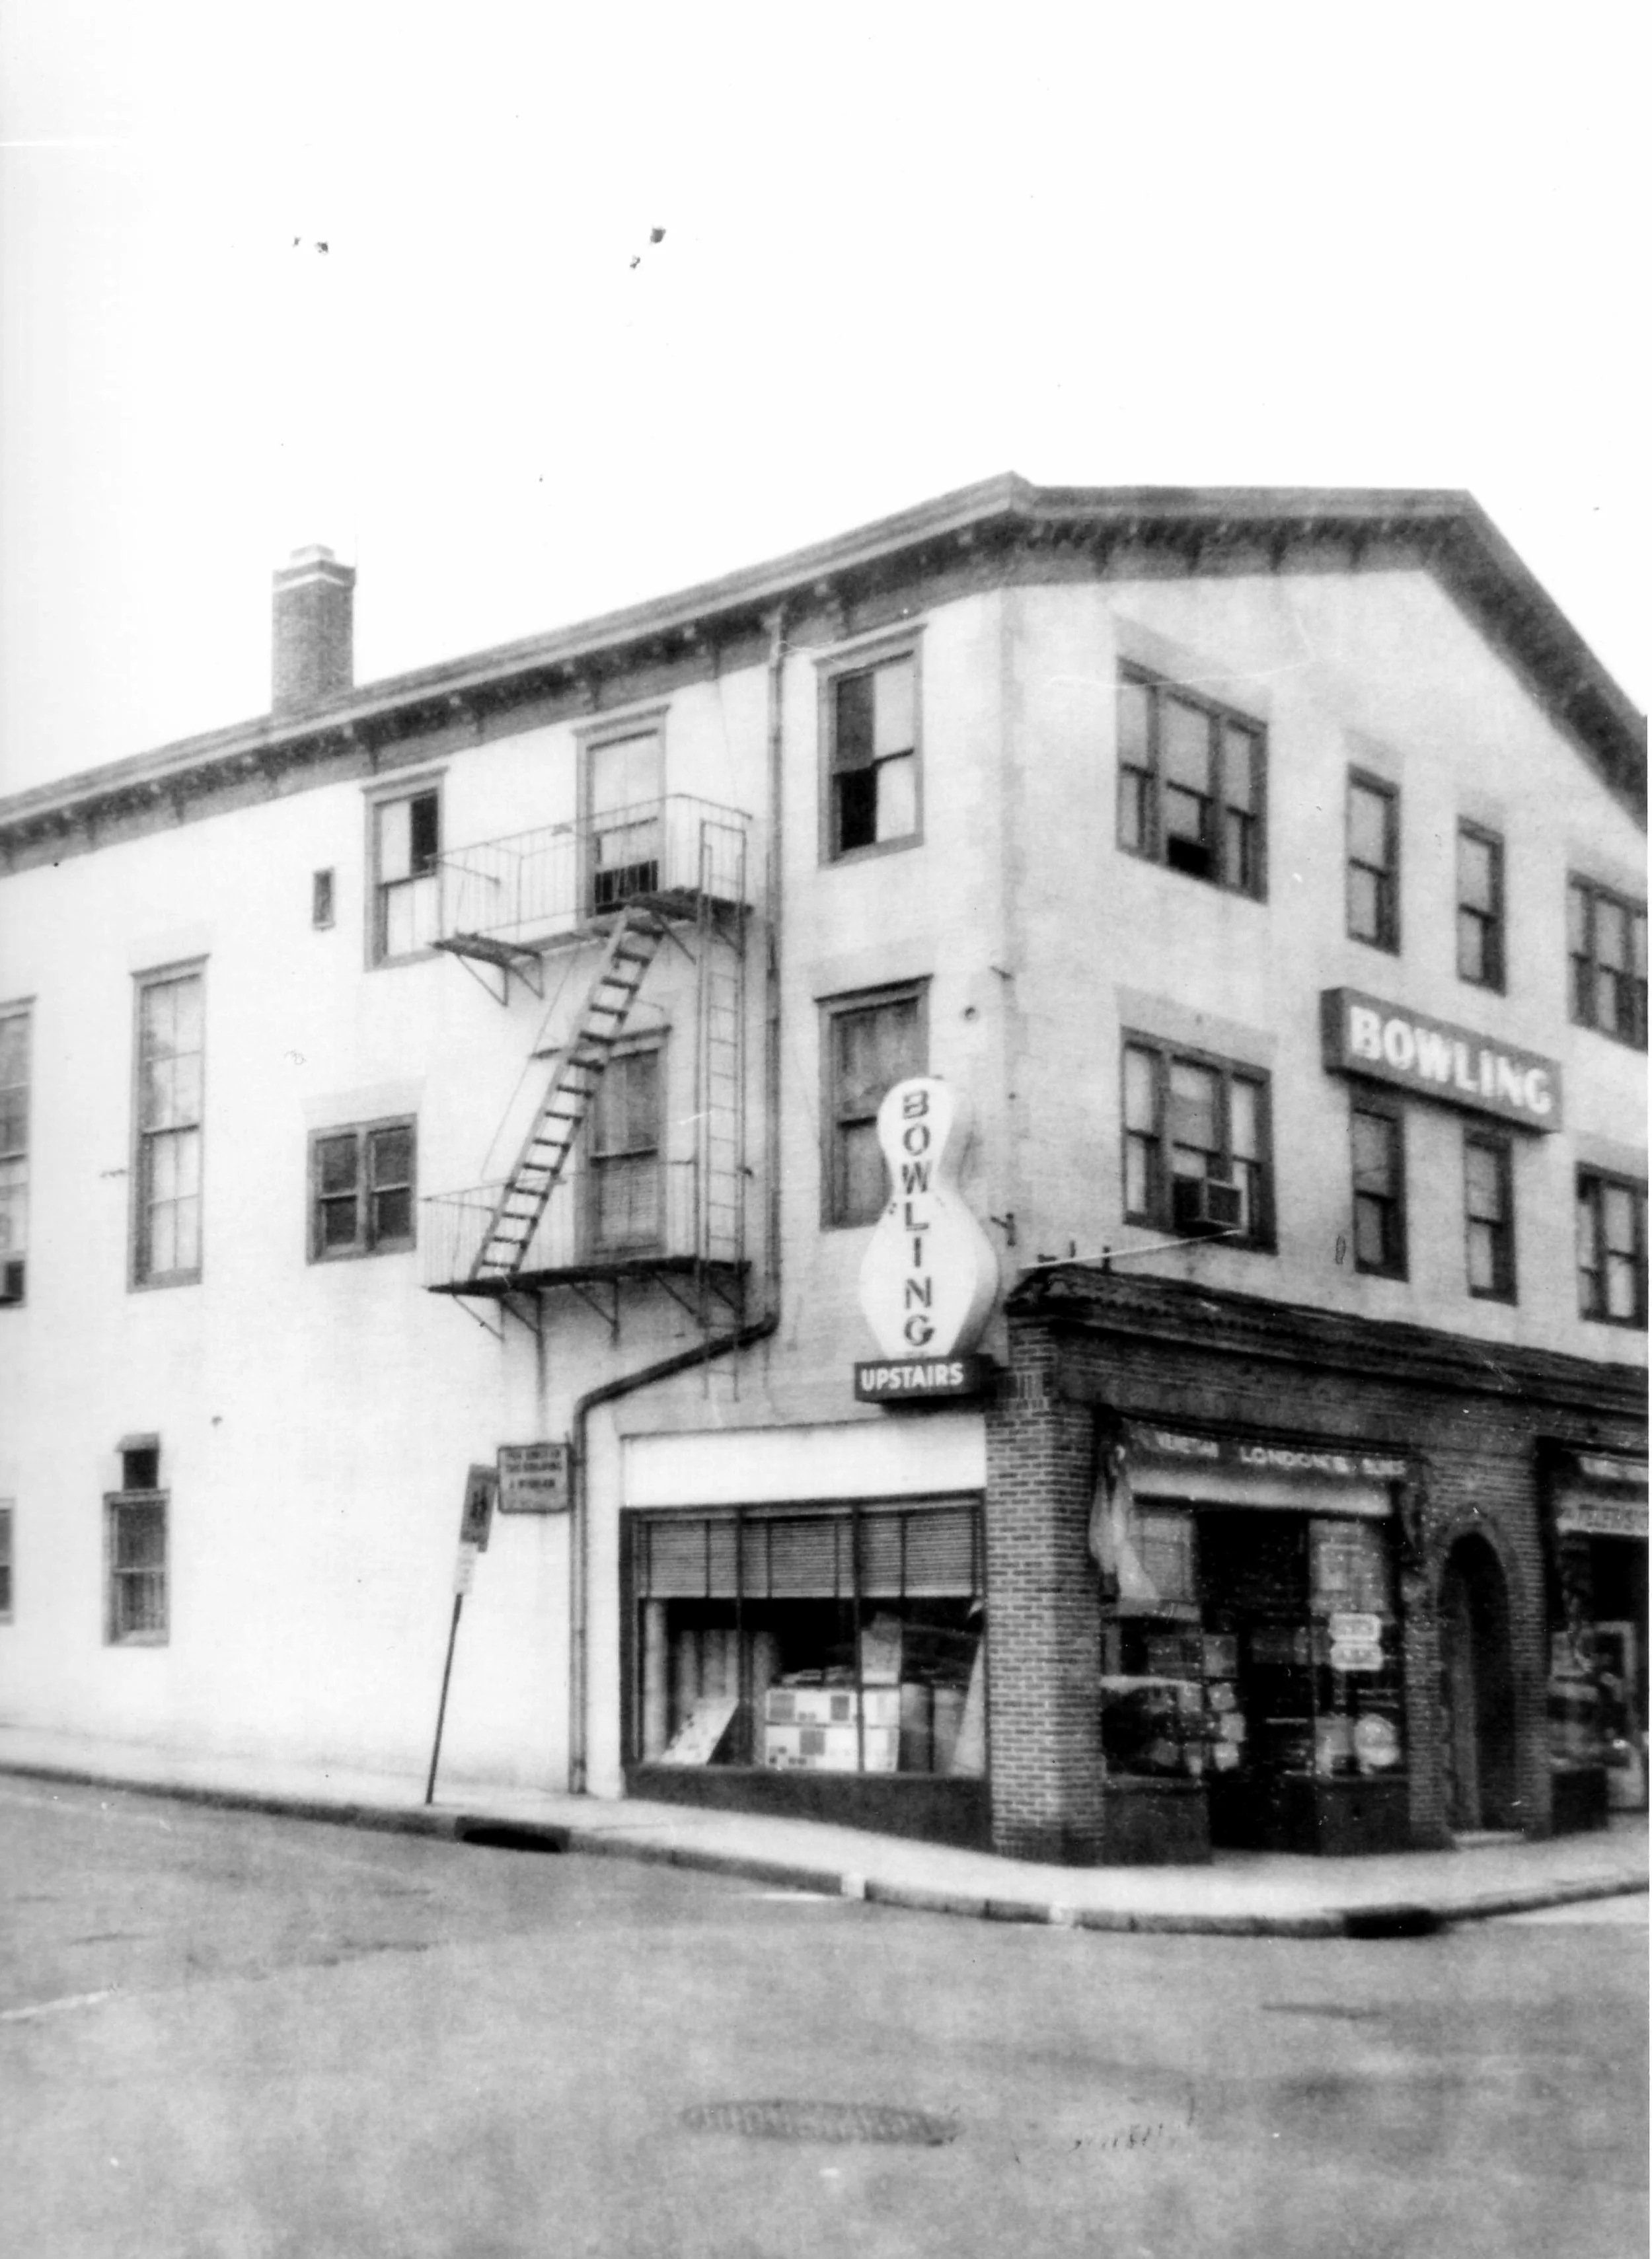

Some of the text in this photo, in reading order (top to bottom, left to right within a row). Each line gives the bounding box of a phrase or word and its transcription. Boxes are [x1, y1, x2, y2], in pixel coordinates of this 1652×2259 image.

[1350, 1006, 1552, 1115] BOWLING
[902, 1090, 935, 1347] BOWLING
[861, 1362, 963, 1391] UPSTAIRS
